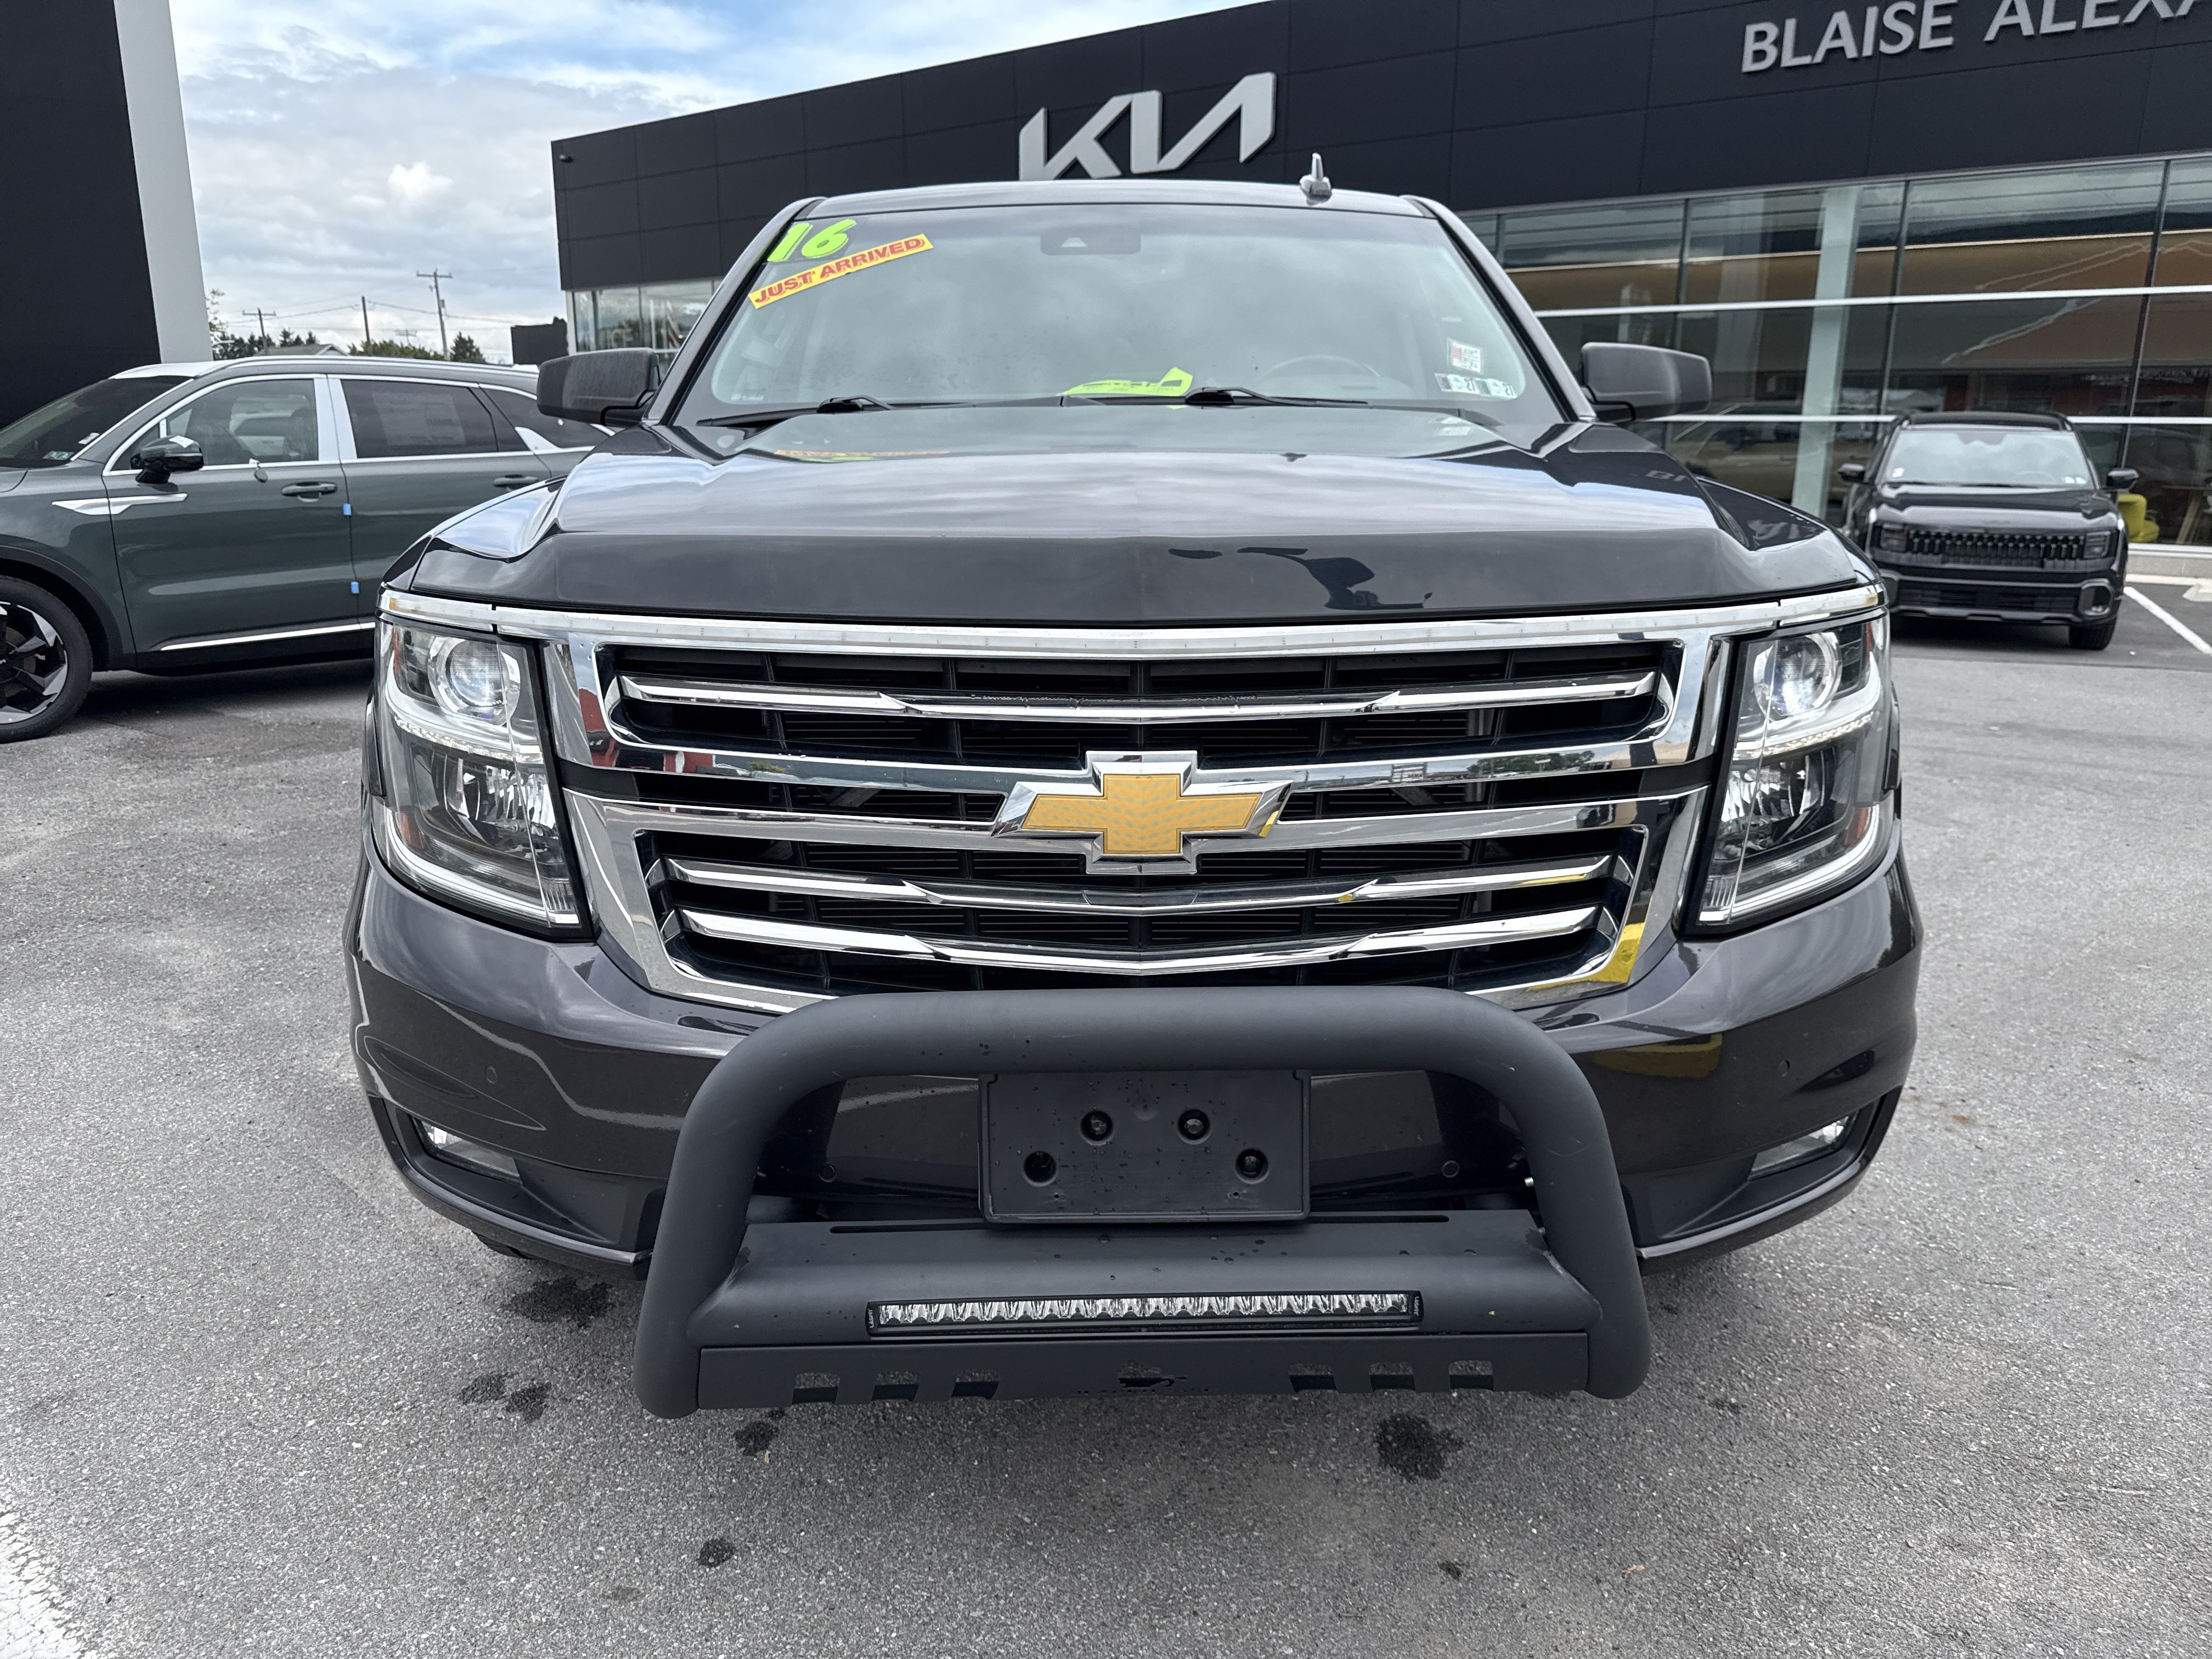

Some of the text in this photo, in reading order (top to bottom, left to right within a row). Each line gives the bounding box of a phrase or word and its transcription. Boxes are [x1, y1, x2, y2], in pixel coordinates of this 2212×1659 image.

[1742, 0, 1956, 72] BLAISE
[1019, 72, 1277, 181] KIA
[755, 238, 926, 304] JUST ARRIVED
[768, 219, 856, 262] 16
